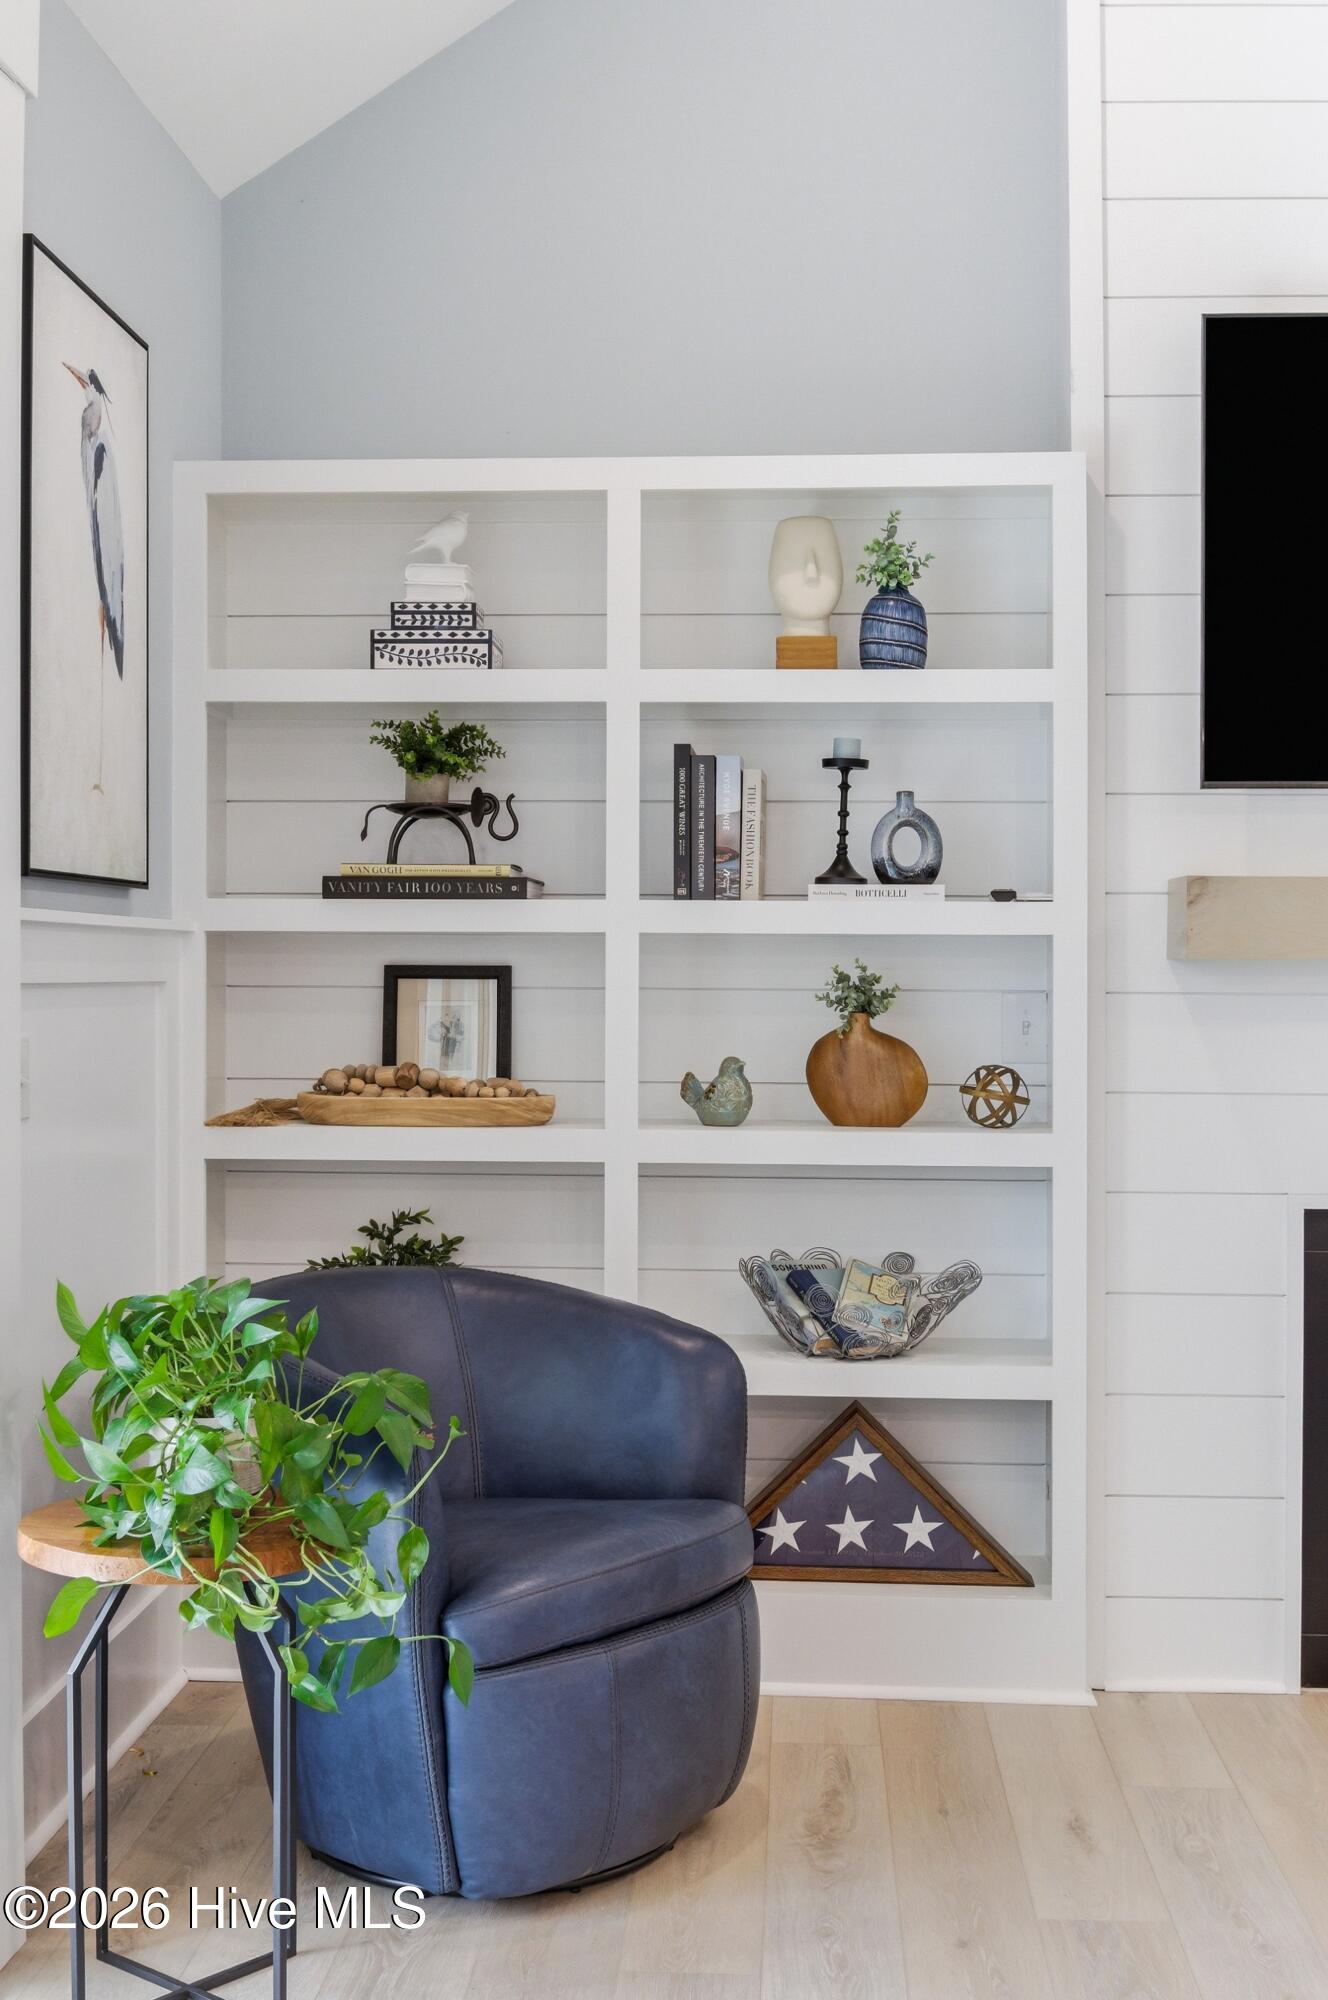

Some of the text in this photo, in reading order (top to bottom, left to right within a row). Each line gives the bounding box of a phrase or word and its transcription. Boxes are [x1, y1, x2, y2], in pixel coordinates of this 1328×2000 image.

[744, 784, 757, 890] THE FASHION BOOK
[349, 866, 370, 874] VAN
[371, 866, 402, 874] GOGH
[328, 881, 503, 894] VANITY FAIR 100 YEARS
[855, 889, 907, 898] BOTTICELLI
